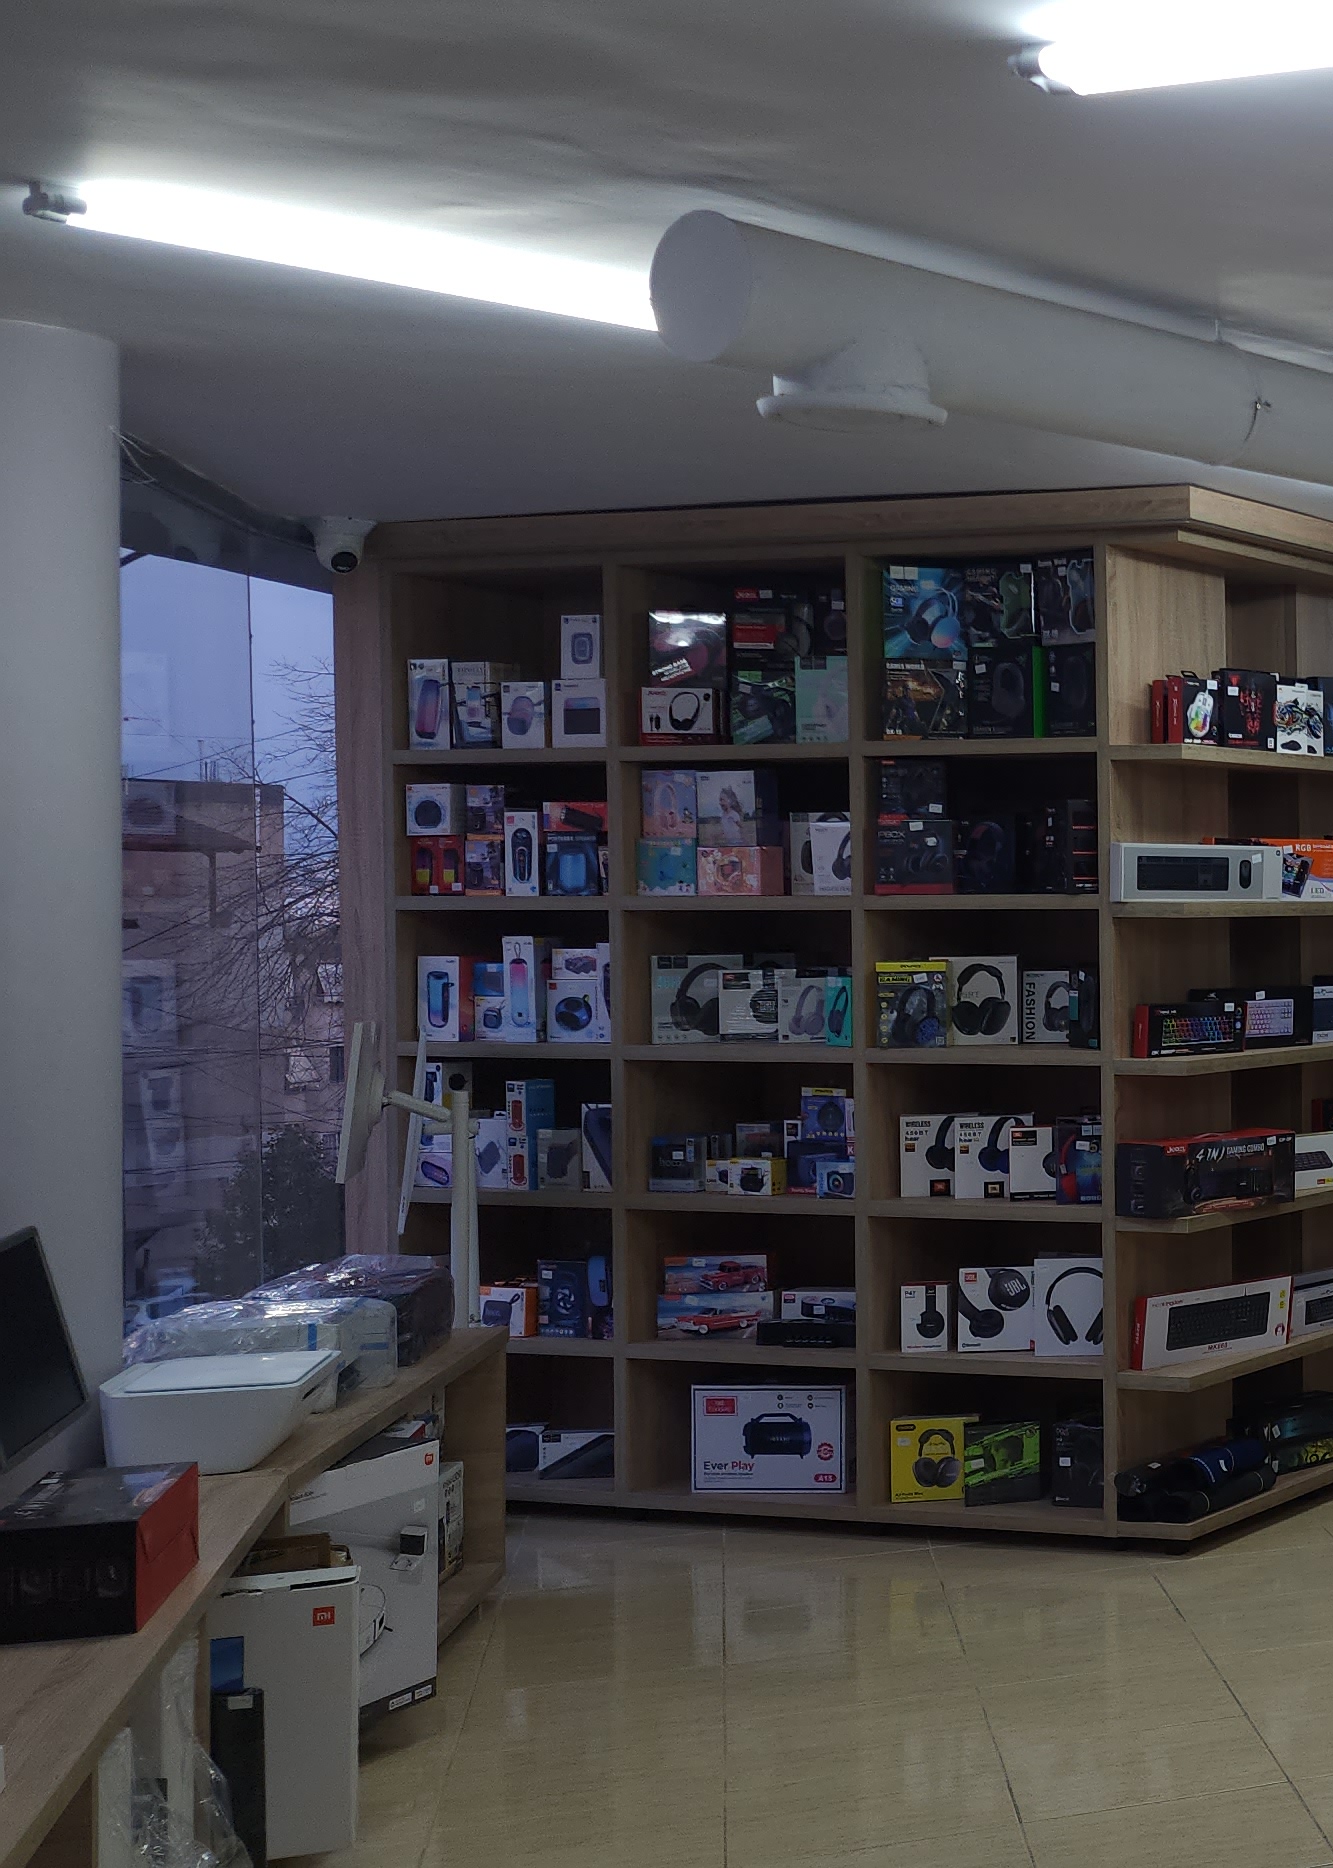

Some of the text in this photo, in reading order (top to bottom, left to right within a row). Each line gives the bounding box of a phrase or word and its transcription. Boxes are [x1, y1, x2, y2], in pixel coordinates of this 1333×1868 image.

[1295, 844, 1311, 852] RGB
[1025, 982, 1035, 1041] FASHION
[1004, 1278, 1026, 1297] JBL
[703, 1460, 755, 1472] Ever Play
